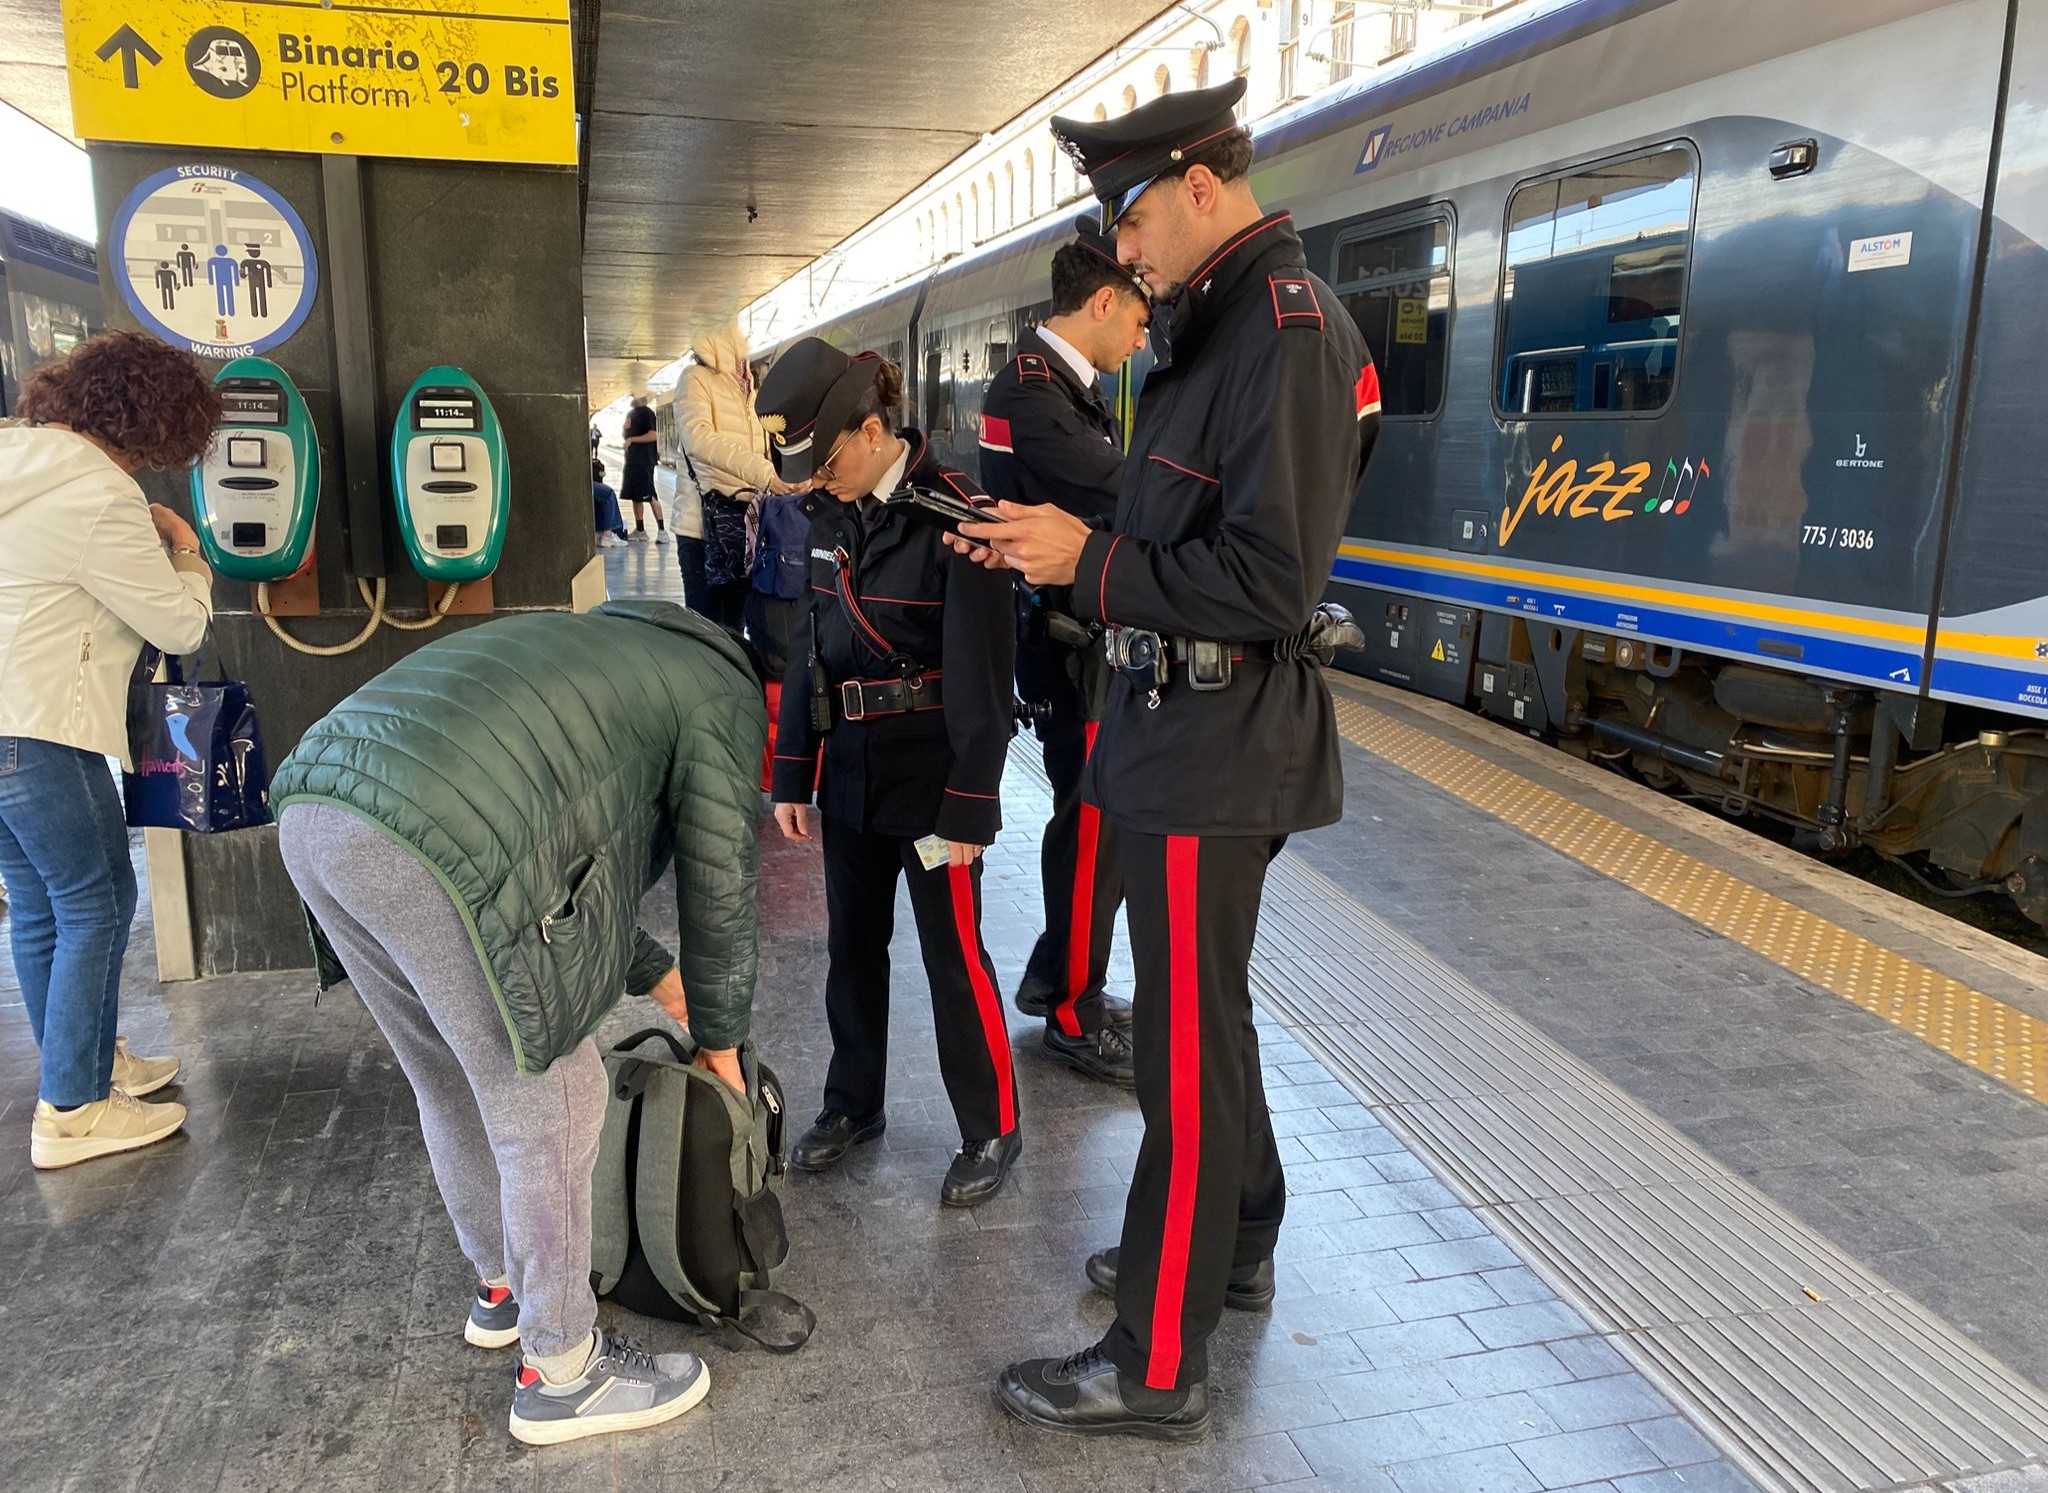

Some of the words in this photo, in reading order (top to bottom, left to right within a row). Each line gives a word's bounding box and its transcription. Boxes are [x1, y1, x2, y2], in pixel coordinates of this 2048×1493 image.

[278, 33, 420, 71] Binario
[437, 60, 490, 95] 20
[504, 65, 560, 98] Bis
[281, 71, 410, 108] Platform
[1383, 122, 1447, 159] REGIONE
[1447, 92, 1531, 138] CAMPANIA
[177, 165, 239, 181] SECURITY
[165, 227, 172, 239] 1
[263, 232, 273, 245] 2
[1860, 238, 1901, 253] ALSTOM
[191, 342, 254, 359] WARNING
[237, 401, 264, 410] 11:14
[434, 408, 460, 417] 11:14
[1835, 459, 1885, 468] BERTONE
[1499, 434, 1651, 547] jazz
[1802, 525, 1827, 546] 775
[1828, 527, 1838, 549] /
[1839, 528, 1875, 550] 3036
[2026, 684, 2042, 694] ASSE
[2018, 693, 2048, 706] BOCCOLA
